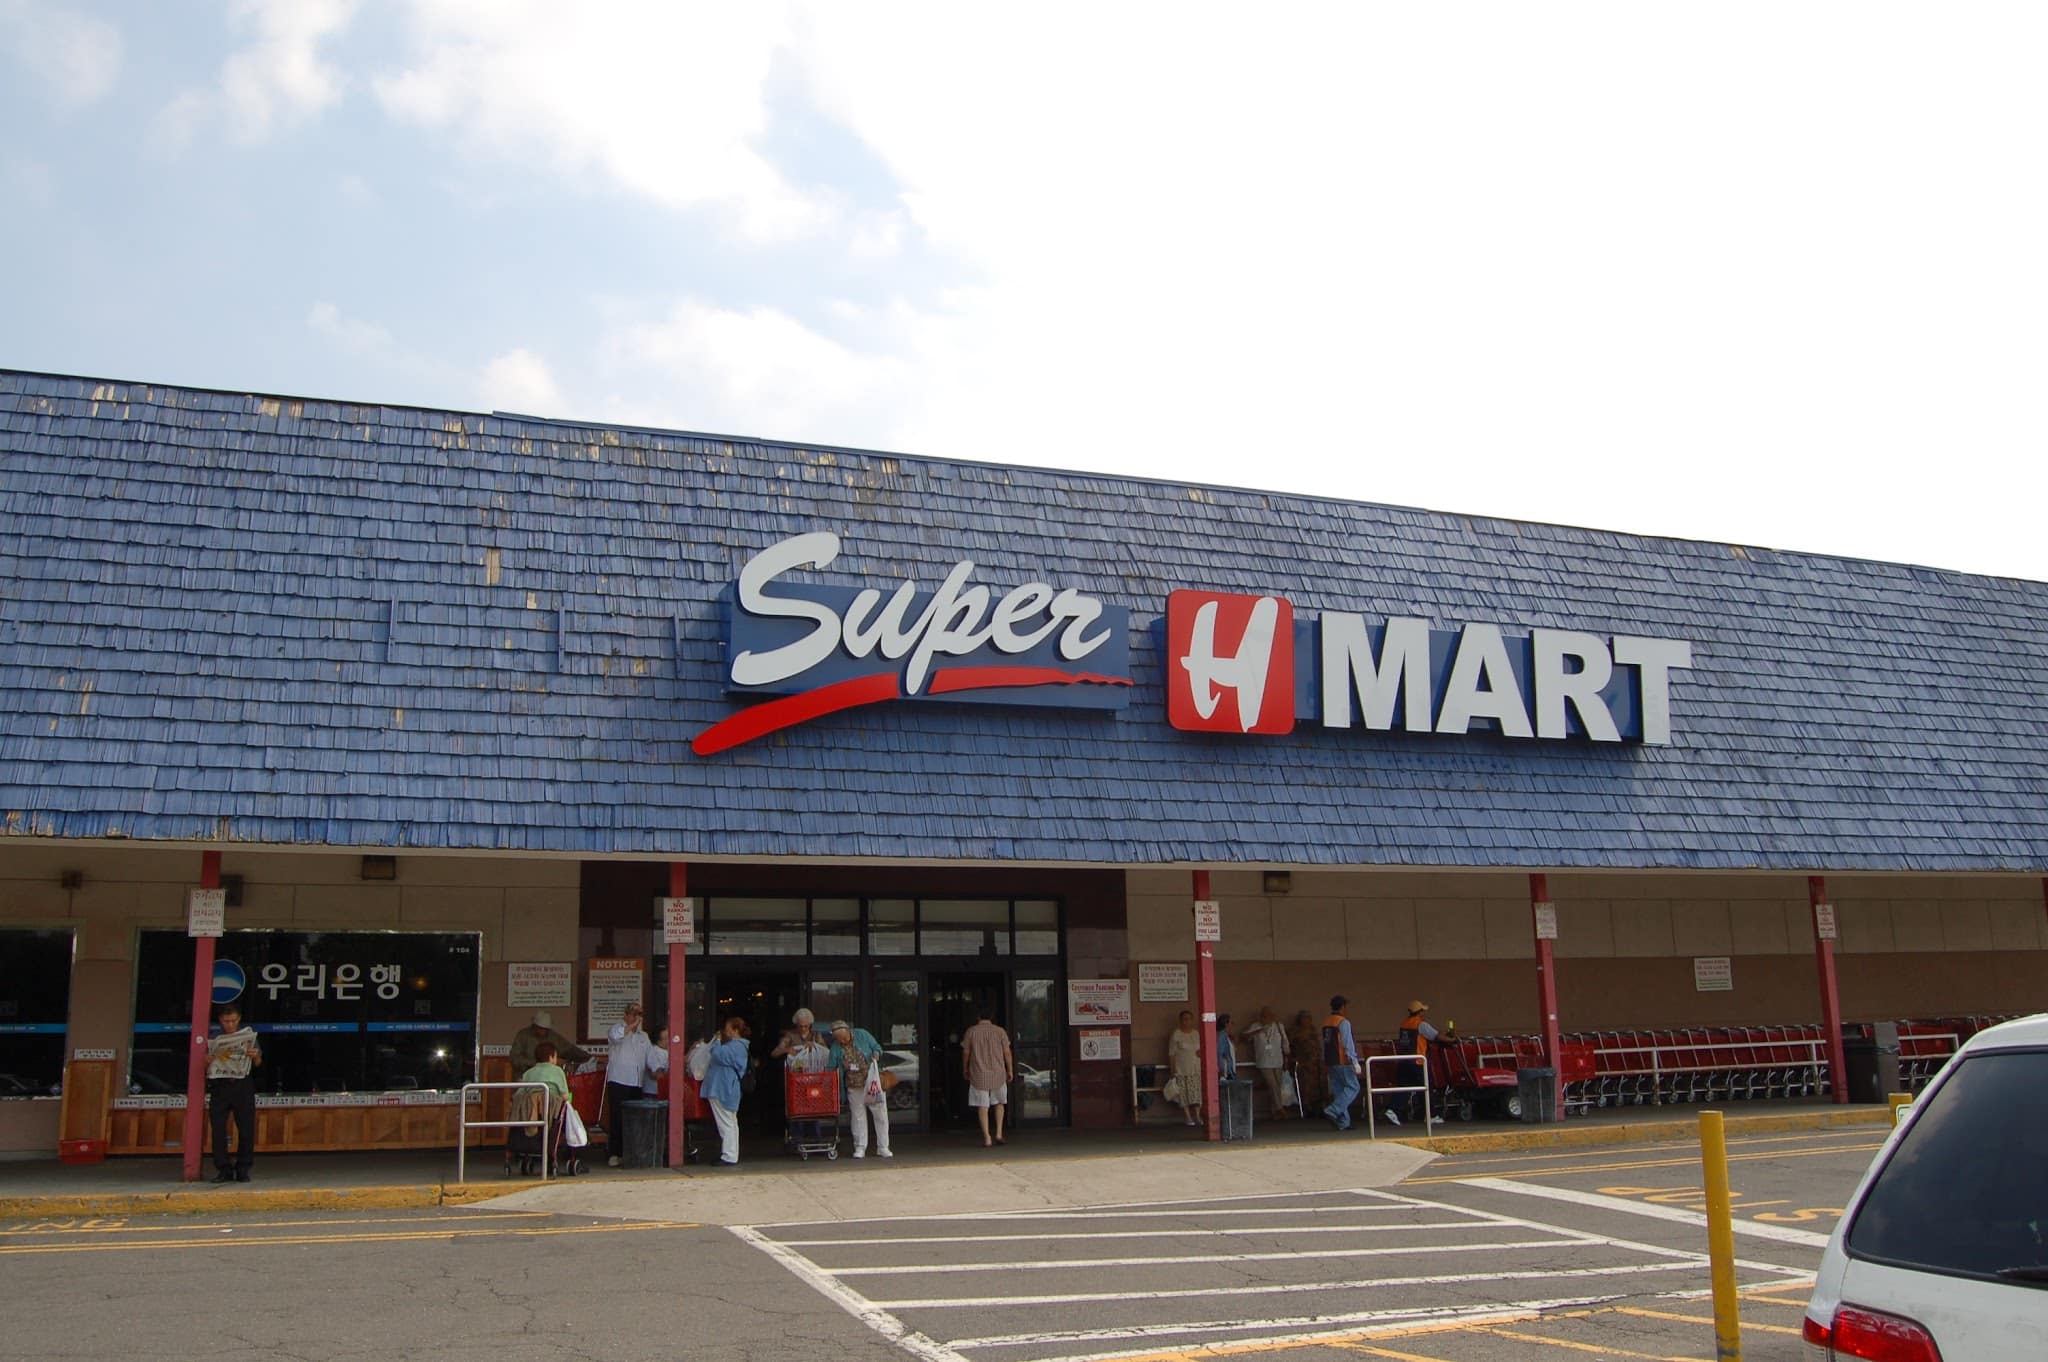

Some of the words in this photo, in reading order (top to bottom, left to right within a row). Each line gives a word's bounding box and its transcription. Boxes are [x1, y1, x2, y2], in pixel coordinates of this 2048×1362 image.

[731, 532, 1112, 696] Super
[1180, 597, 1279, 734] H
[1320, 611, 1692, 746] MART
[257, 963, 401, 1000] 우리은행
[596, 960, 637, 969] NOTICE
